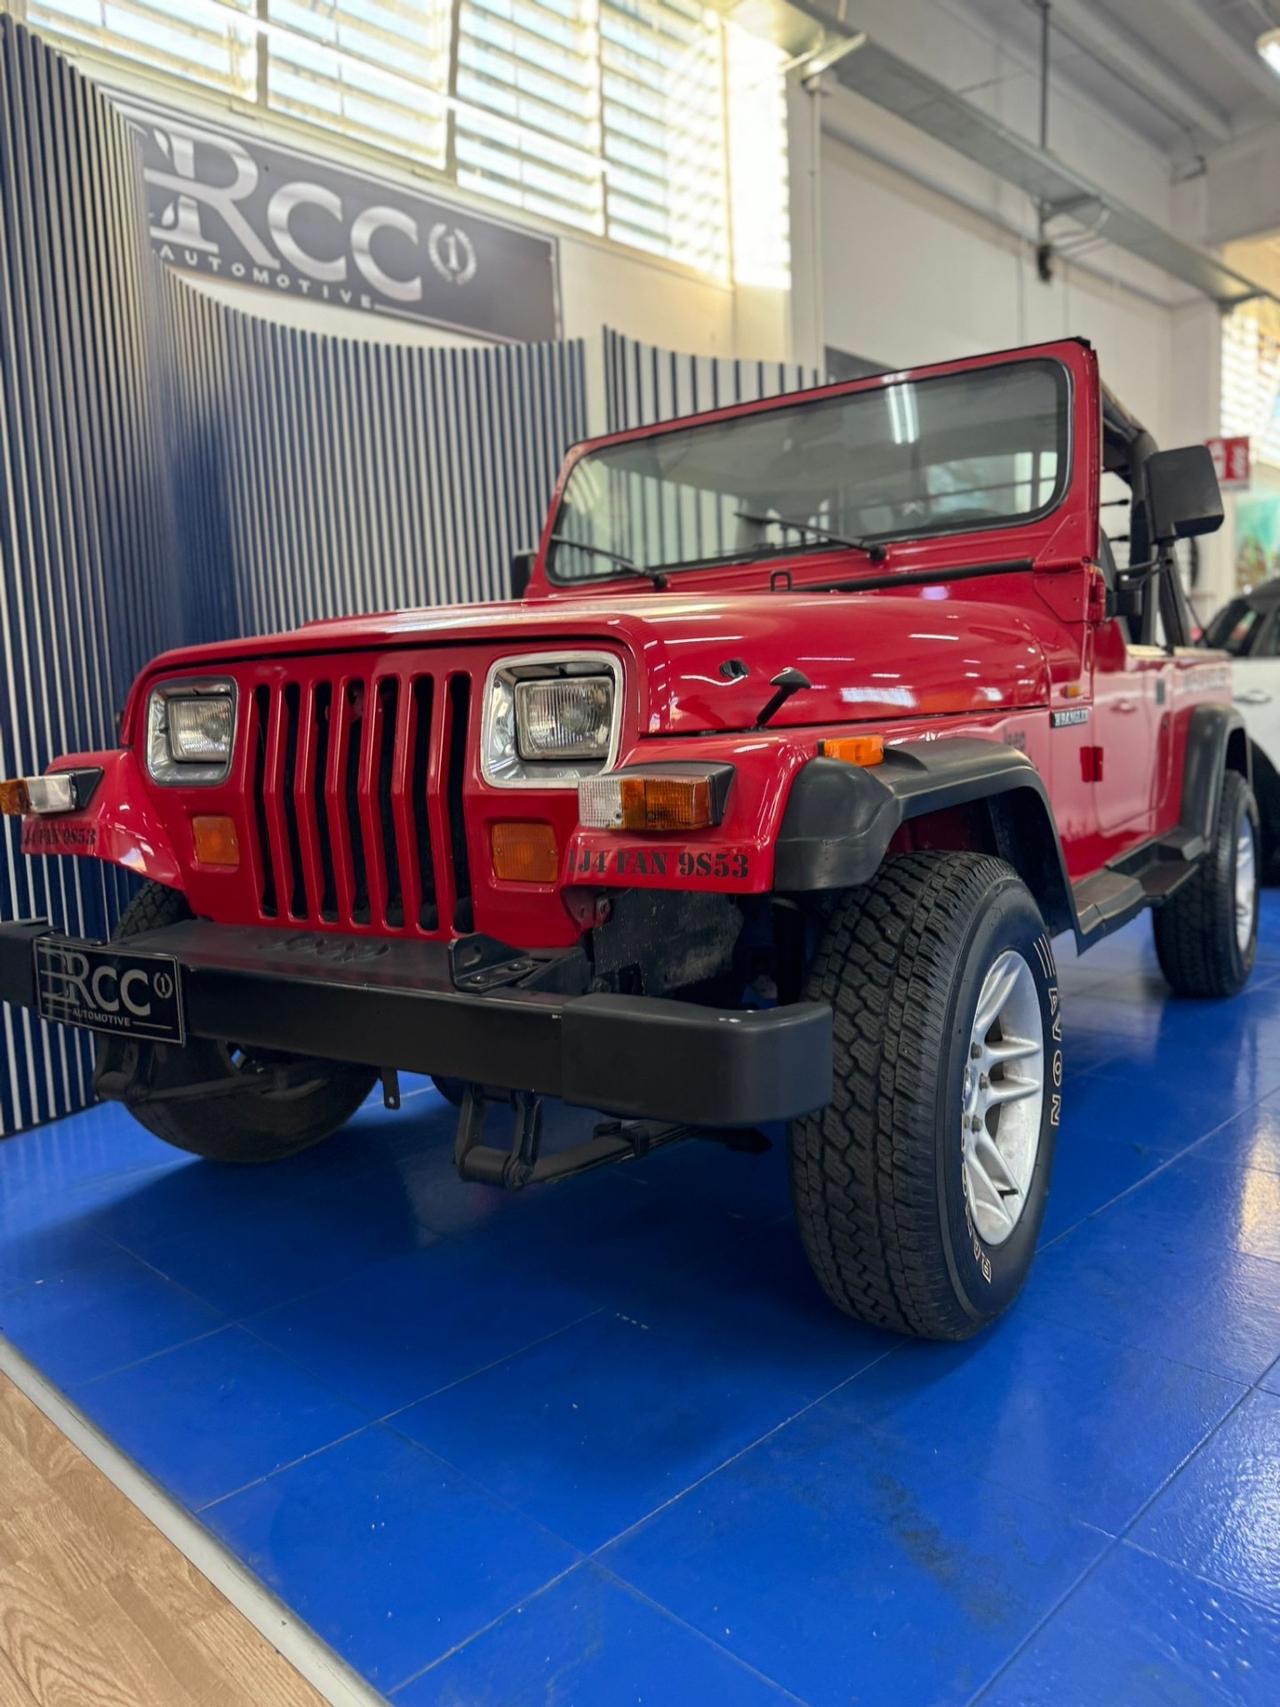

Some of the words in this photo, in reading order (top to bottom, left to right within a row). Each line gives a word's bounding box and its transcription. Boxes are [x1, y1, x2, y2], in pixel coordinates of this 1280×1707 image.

[159, 244, 372, 309] AUTOMOTIVE
[616, 848, 668, 874] FAN
[72, 1006, 131, 1027] AUTOMOTIVE
[1048, 987, 1062, 1126] AVON
